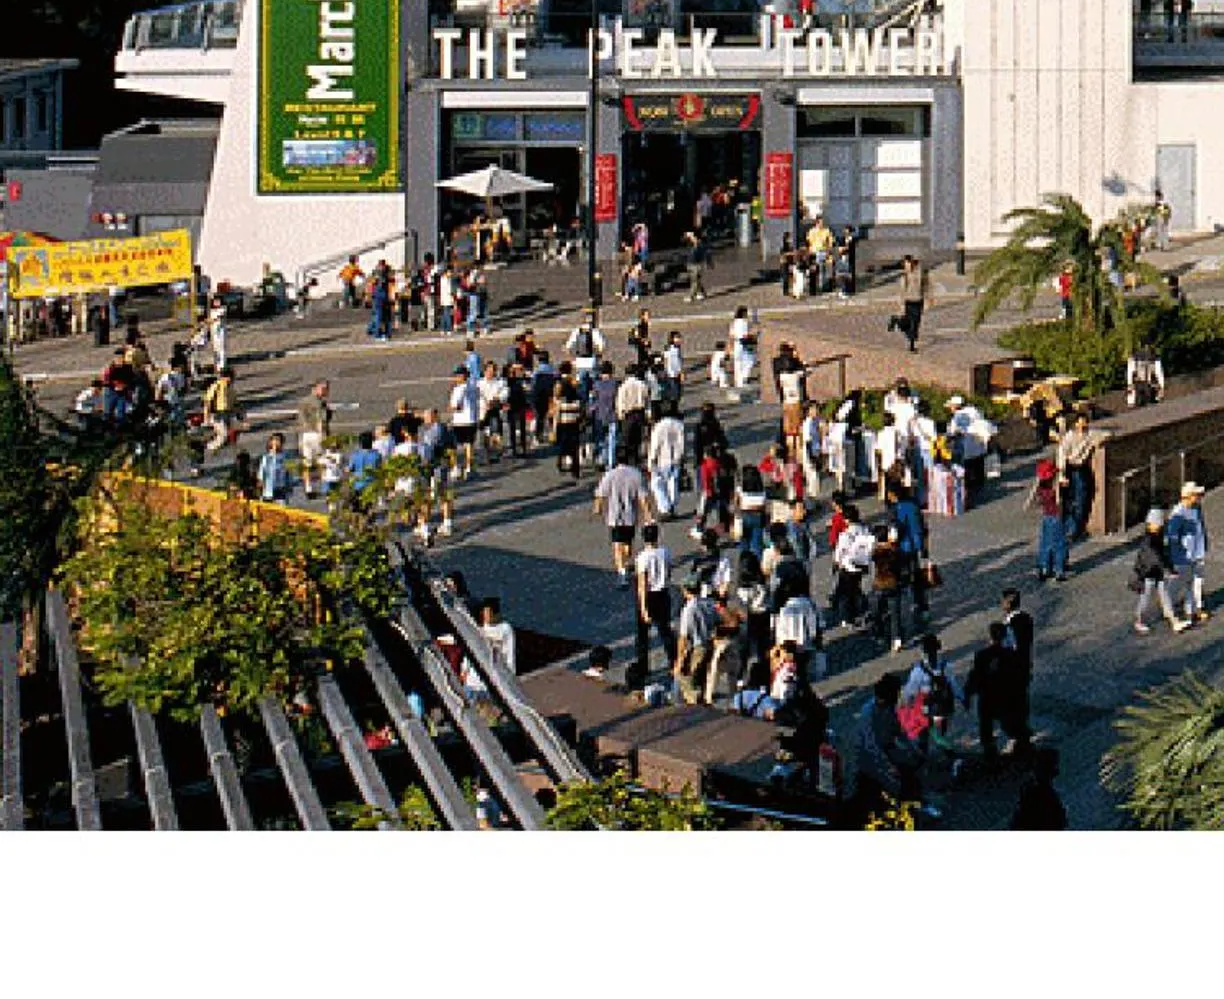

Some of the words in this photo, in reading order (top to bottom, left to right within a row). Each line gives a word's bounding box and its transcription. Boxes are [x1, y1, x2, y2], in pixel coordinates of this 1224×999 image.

[433, 28, 526, 80] THE
[588, 28, 719, 80] PEAK
[777, 28, 953, 76] TOWER
